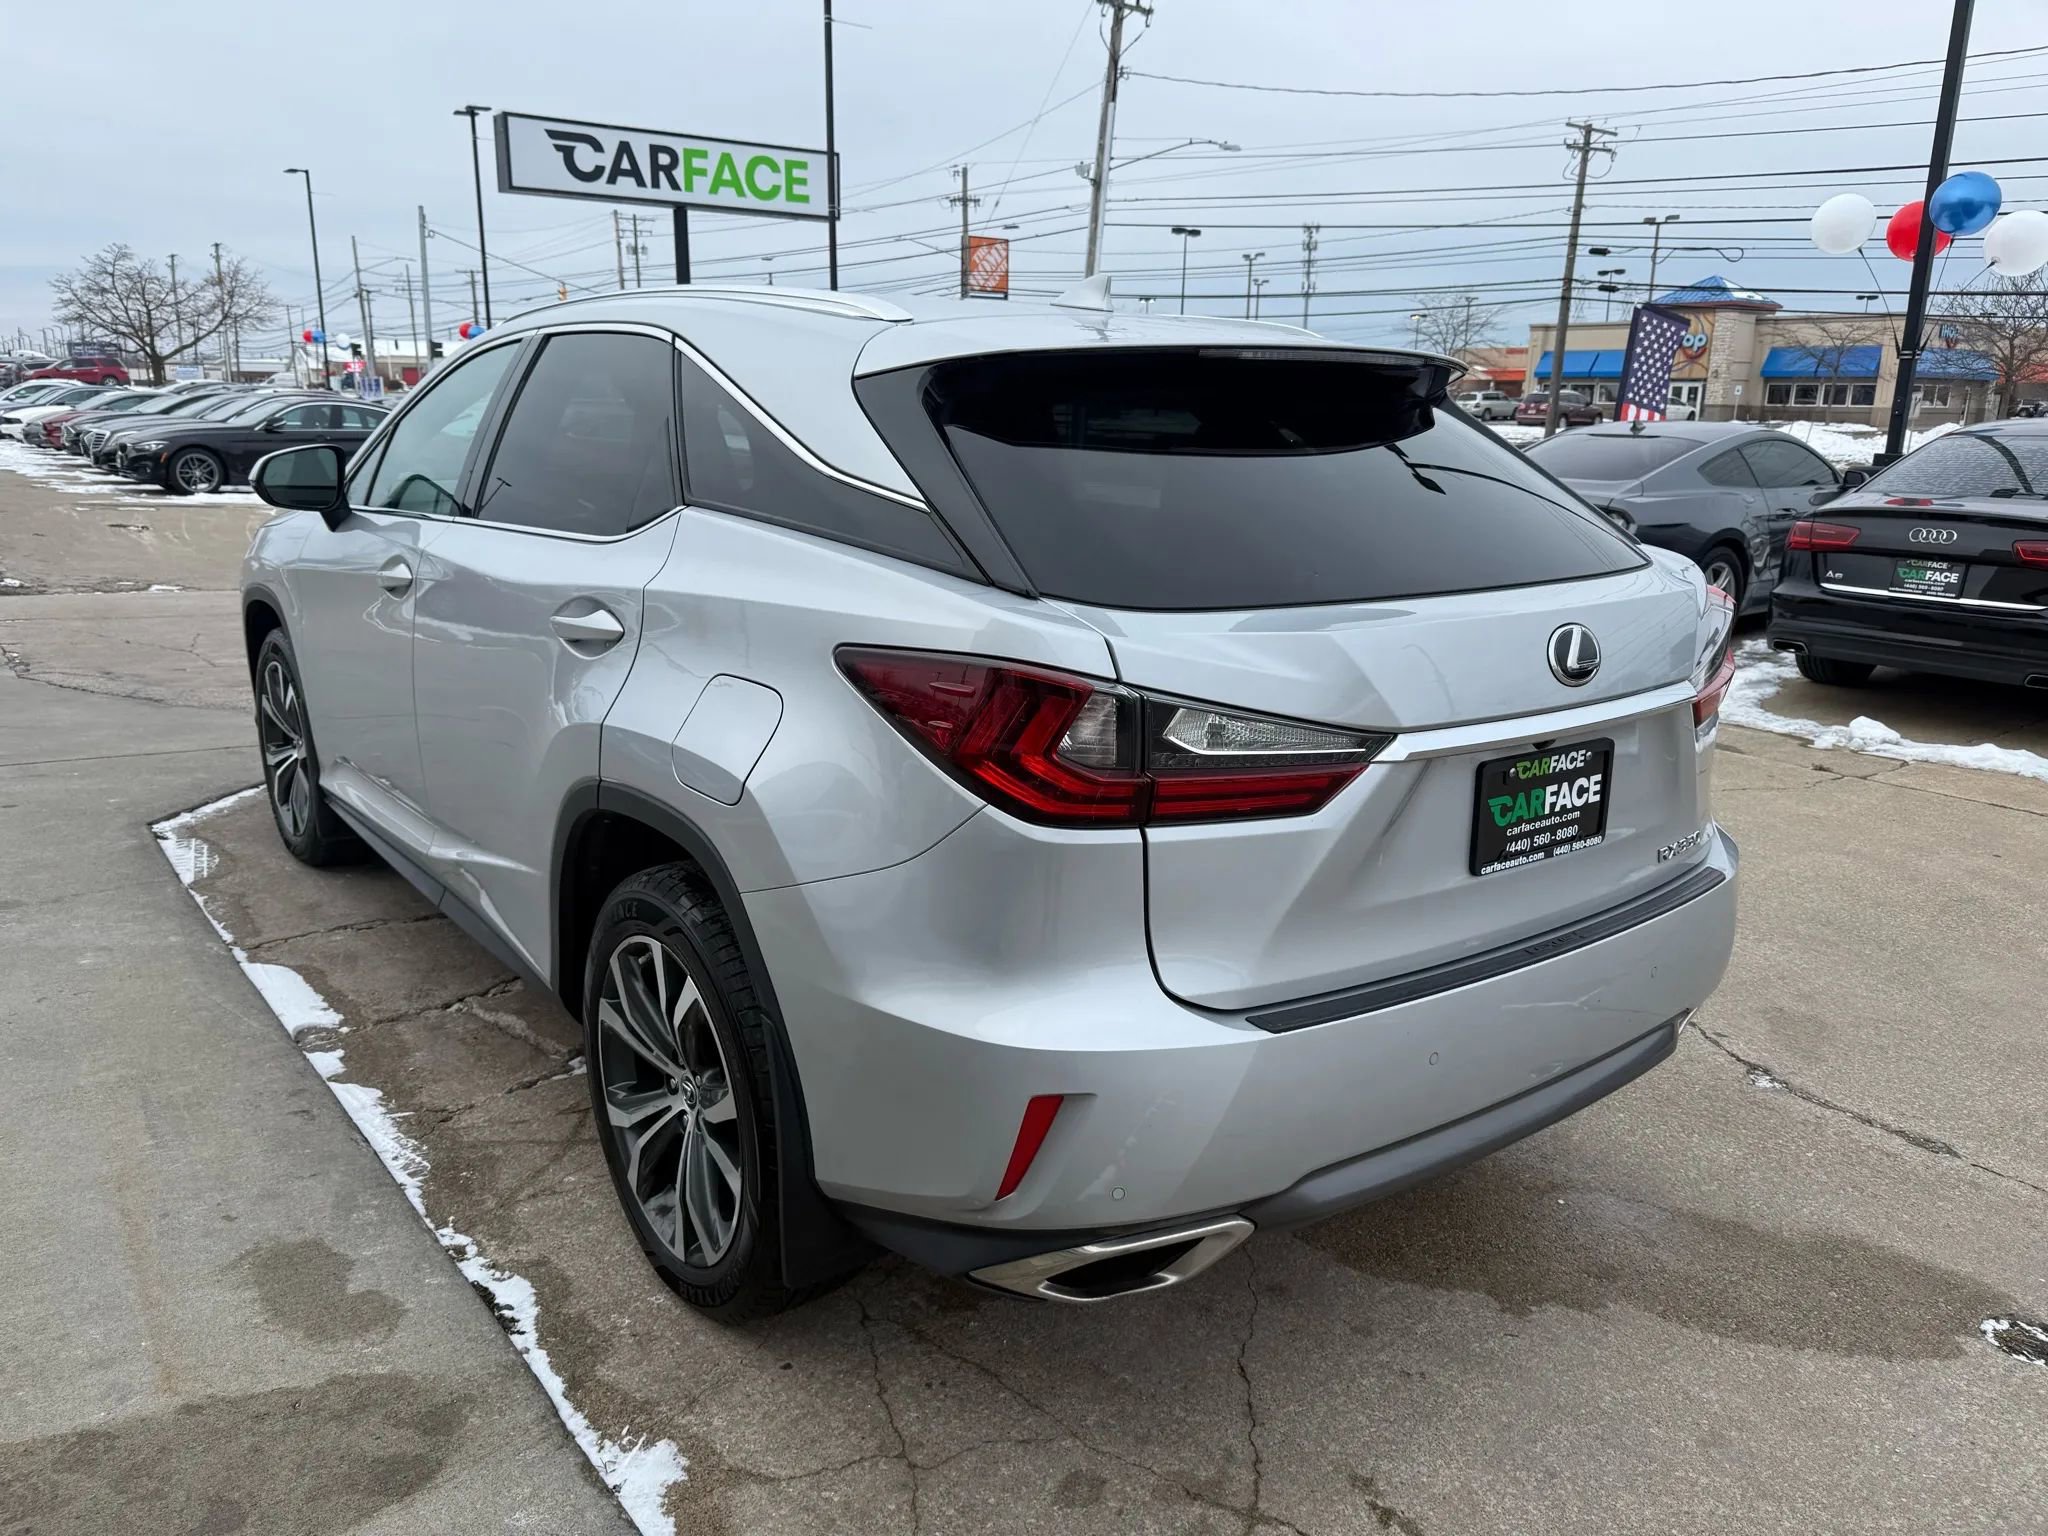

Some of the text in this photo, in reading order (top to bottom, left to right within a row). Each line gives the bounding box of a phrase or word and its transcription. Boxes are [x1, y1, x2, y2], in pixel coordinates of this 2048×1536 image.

[544, 128, 810, 204] CARFACE
[1897, 567, 1960, 583] CARFACE
[1515, 749, 1587, 779] CARFACE
[1488, 774, 1602, 827] CARFACE
[1506, 810, 1581, 837] carfaceauto.com
[1506, 824, 1579, 853] (440) 560-8080
[1481, 850, 1545, 875] carfaceauto.com
